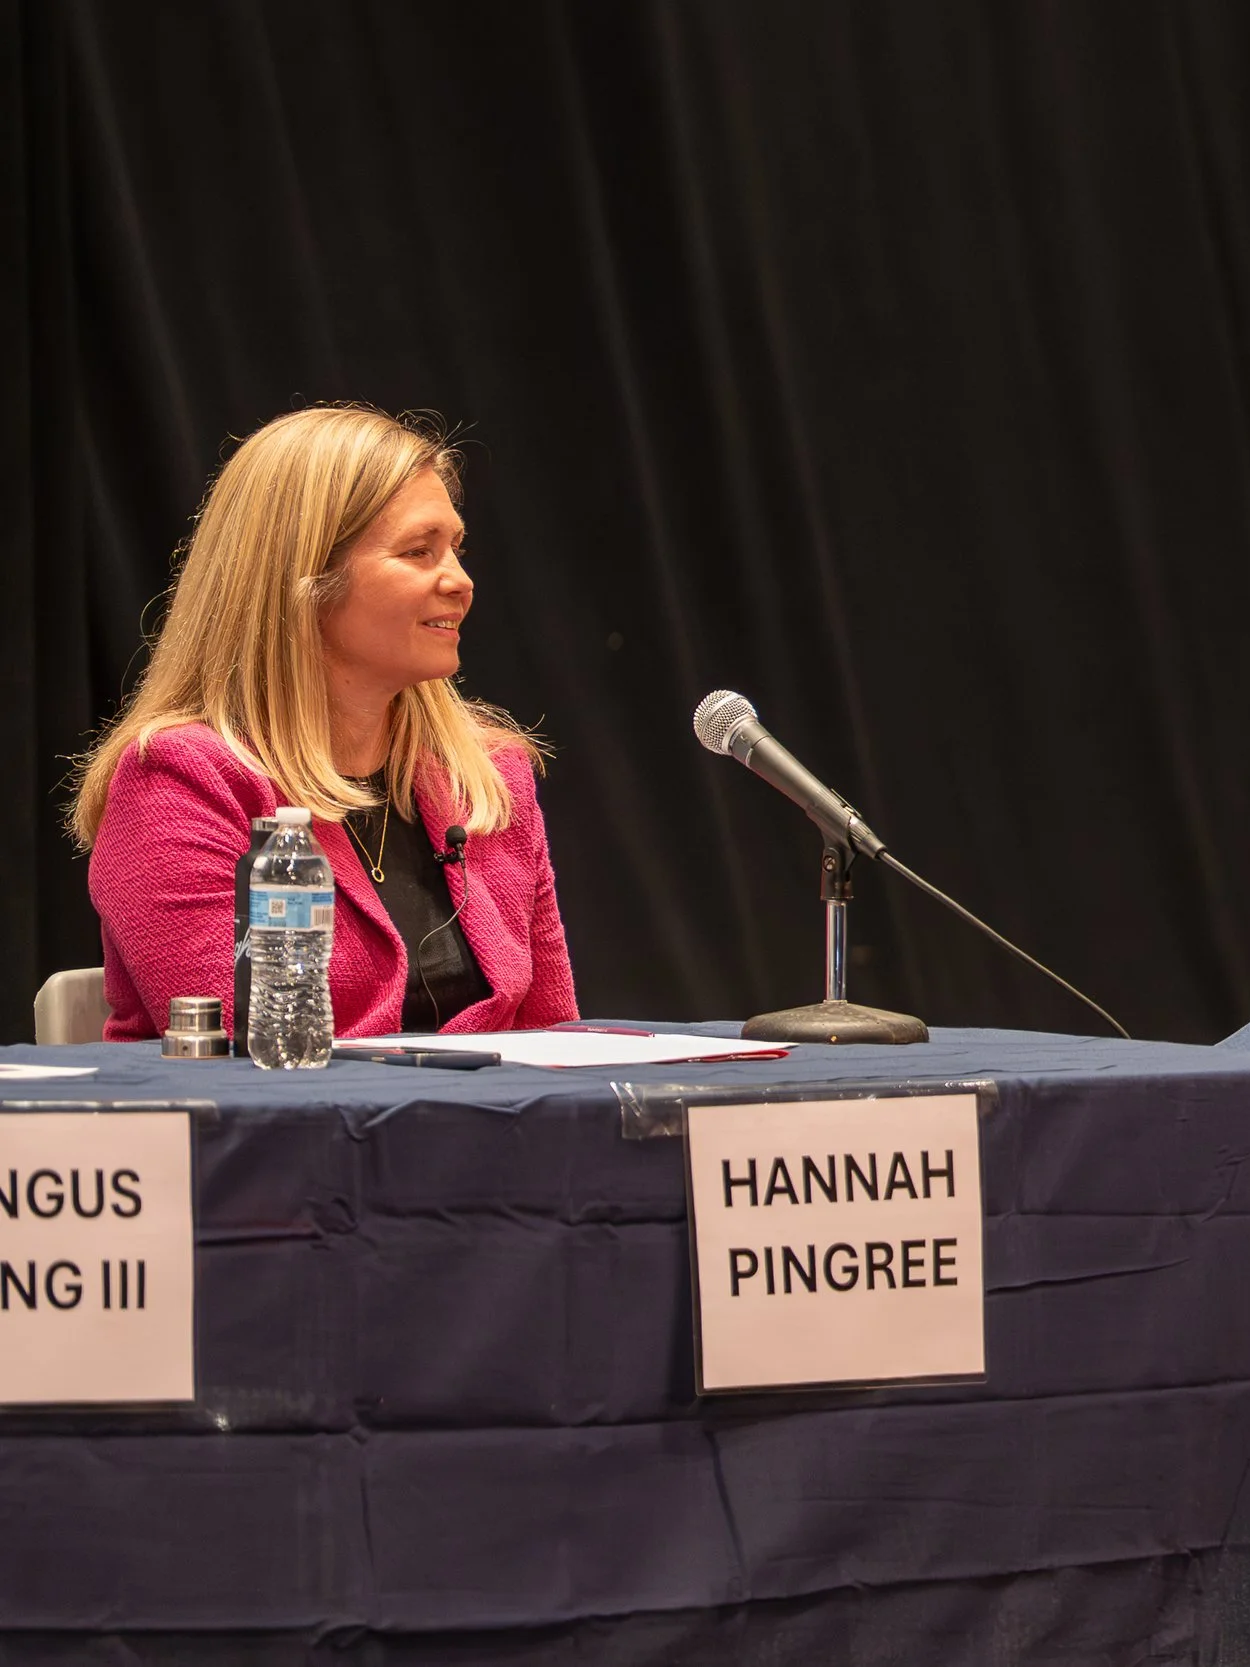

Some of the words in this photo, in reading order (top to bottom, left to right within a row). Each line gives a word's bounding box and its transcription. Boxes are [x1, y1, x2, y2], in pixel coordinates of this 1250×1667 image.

[721, 1149, 956, 1208] HANNAH
[101, 1259, 146, 1310] III
[728, 1237, 958, 1297] PINGREE
